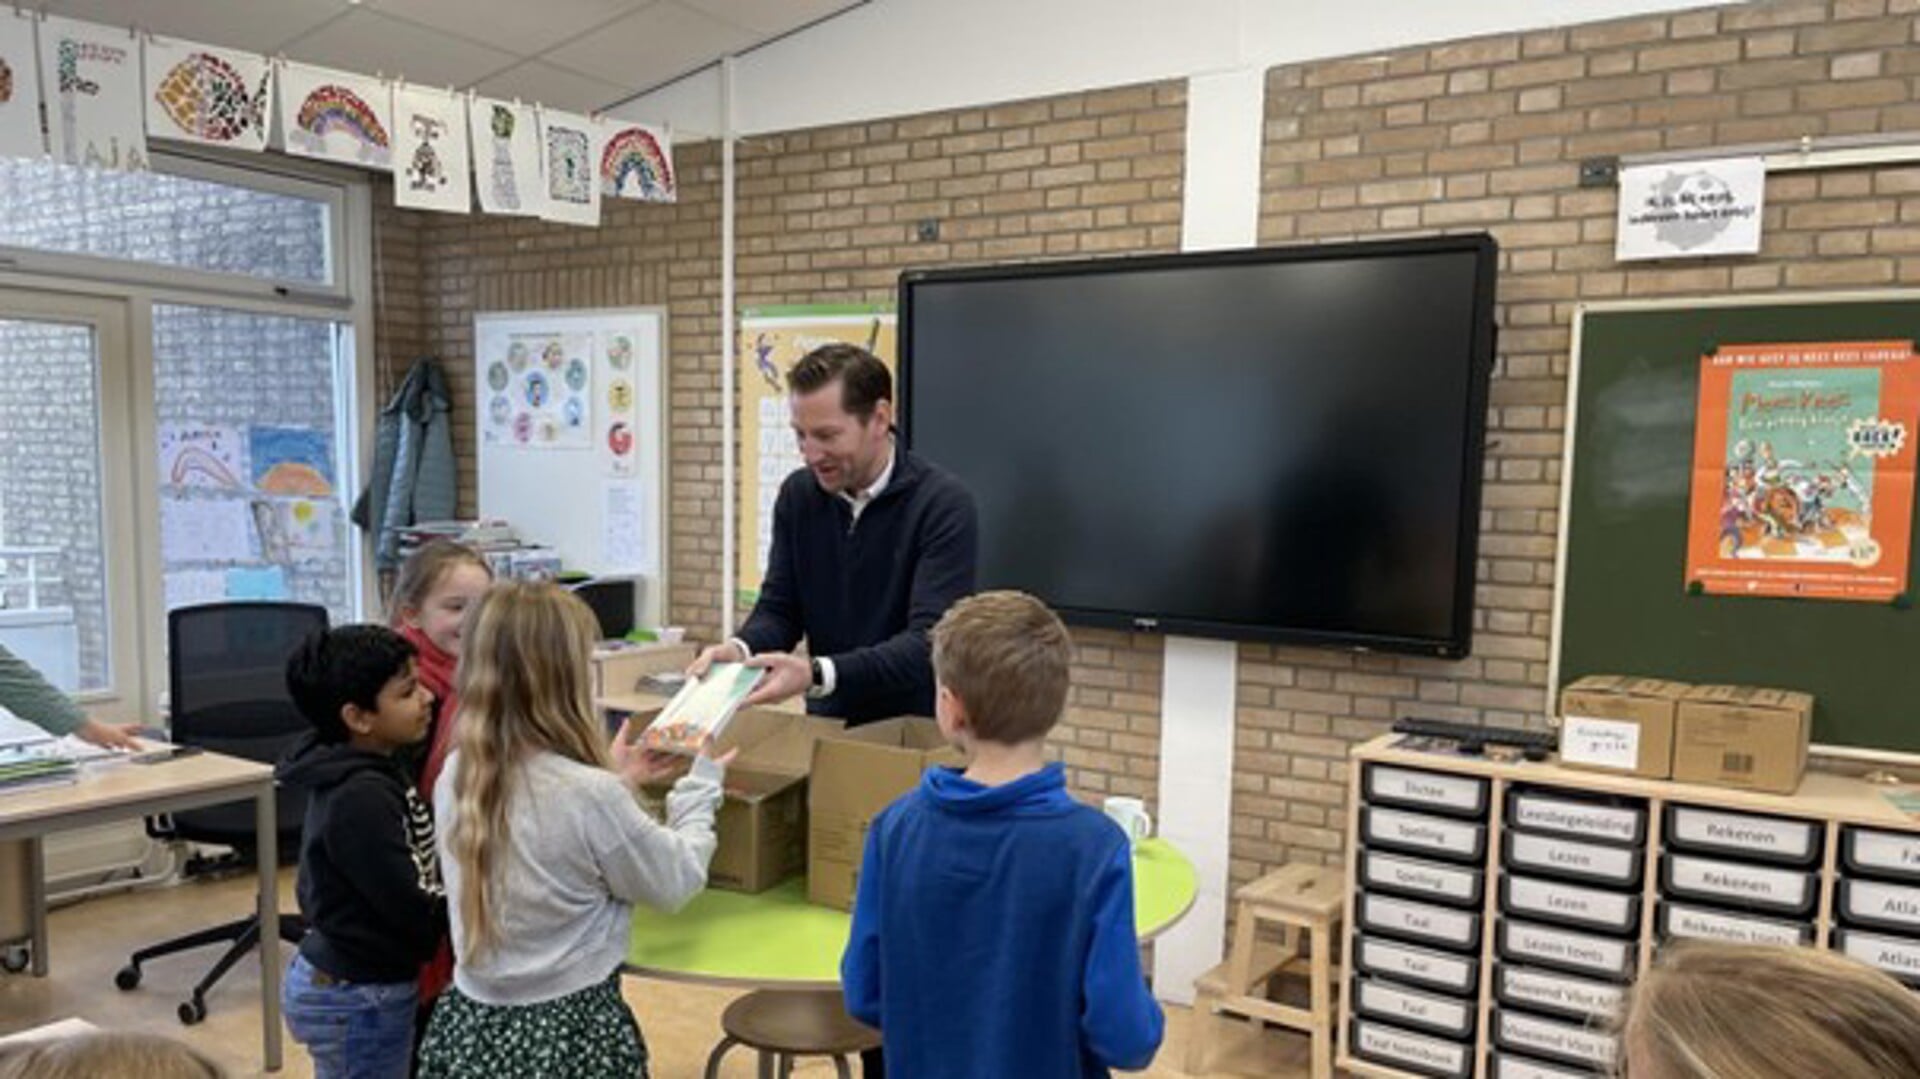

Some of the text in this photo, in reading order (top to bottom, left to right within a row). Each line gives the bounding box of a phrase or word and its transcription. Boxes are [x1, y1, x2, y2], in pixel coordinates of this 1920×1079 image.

[1519, 807, 1633, 836] Leesbegeleiding
[1398, 823, 1444, 845] Spelling
[1706, 823, 1775, 844] Rekenen
[1548, 848, 1591, 866] Lezen
[1395, 867, 1442, 889] Spelling
[1702, 871, 1771, 894] Rekenen
[1546, 894, 1588, 911] Lezen
[1404, 912, 1430, 928] Taal
[1681, 918, 1747, 941] Rekenen
[1523, 936, 1564, 953] Lezen
[1403, 957, 1429, 973] Taal
[1401, 1000, 1426, 1015] Taal
